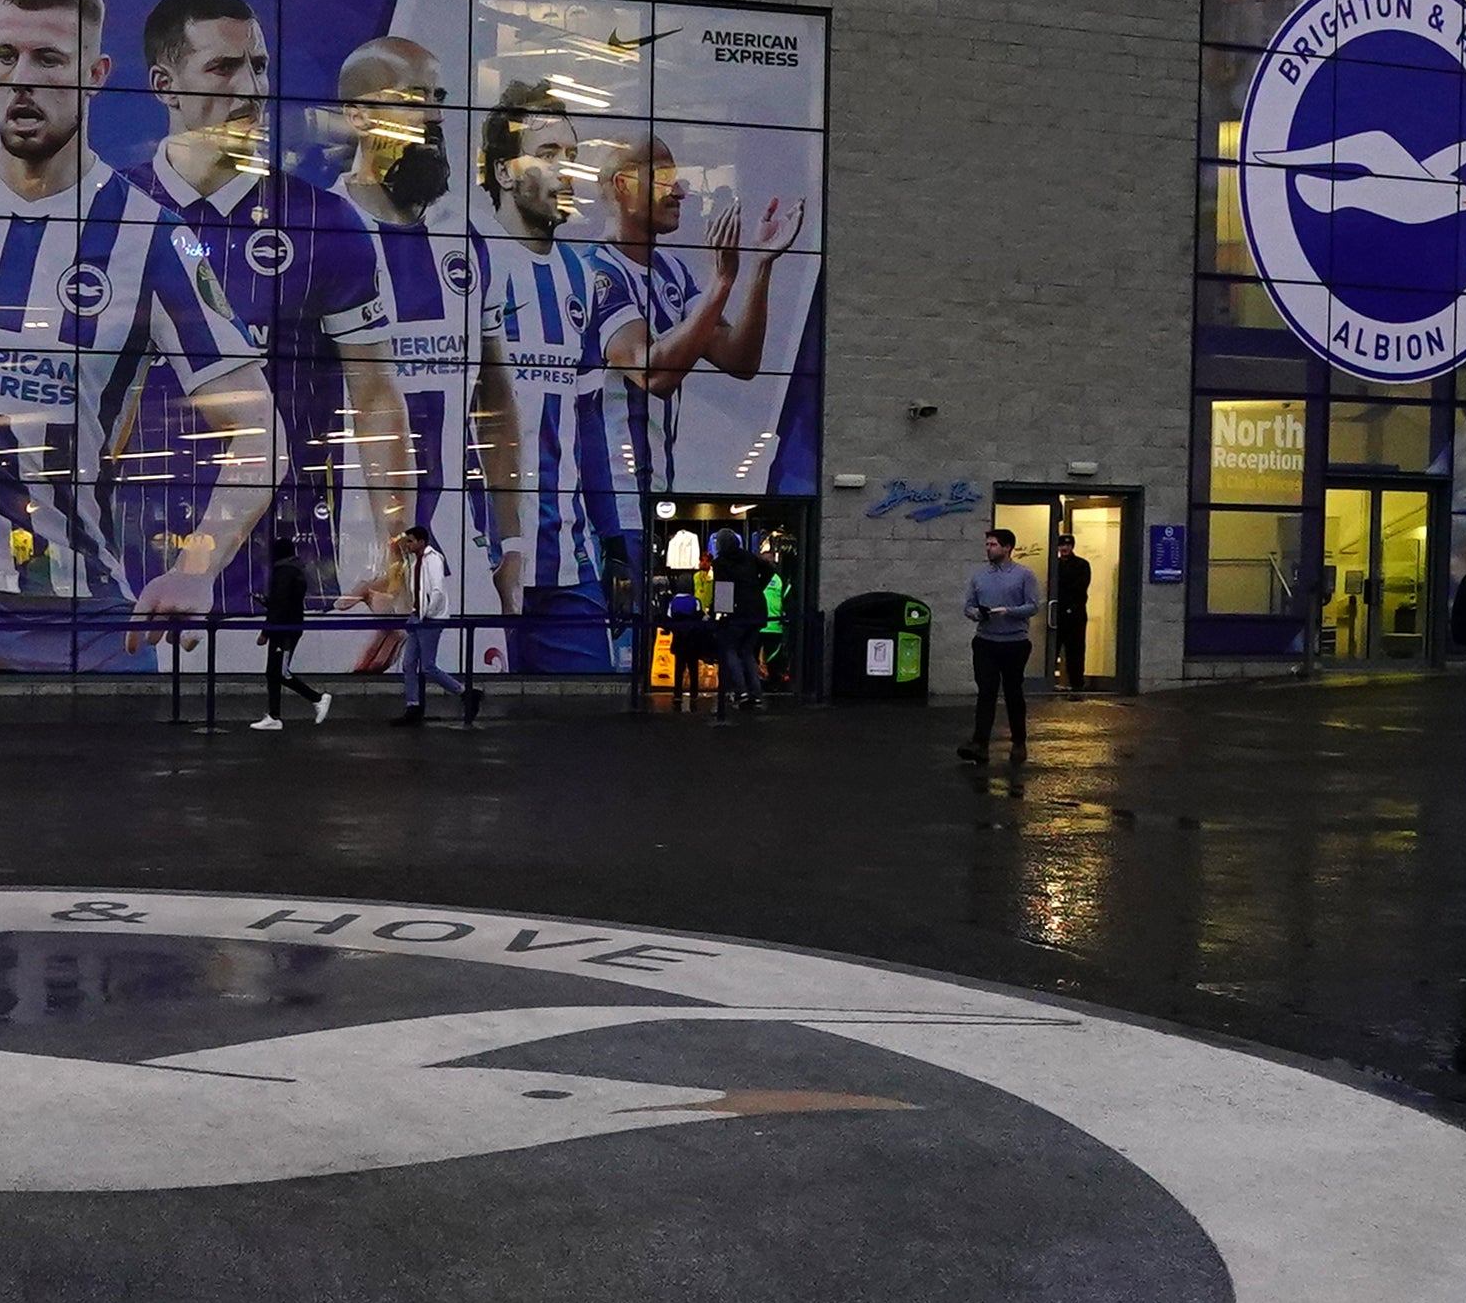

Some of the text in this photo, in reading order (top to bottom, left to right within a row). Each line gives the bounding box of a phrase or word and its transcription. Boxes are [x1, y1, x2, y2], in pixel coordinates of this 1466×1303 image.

[1428, 3, 1444, 32] &
[701, 30, 798, 51] AMERICAN
[714, 48, 799, 67] EXPRESS
[1332, 320, 1446, 362] ALBION
[514, 368, 575, 385] XPRESS
[1213, 409, 1306, 449] North
[1212, 446, 1305, 474] Reception
[49, 900, 150, 925] &
[244, 908, 722, 973] HOVE
